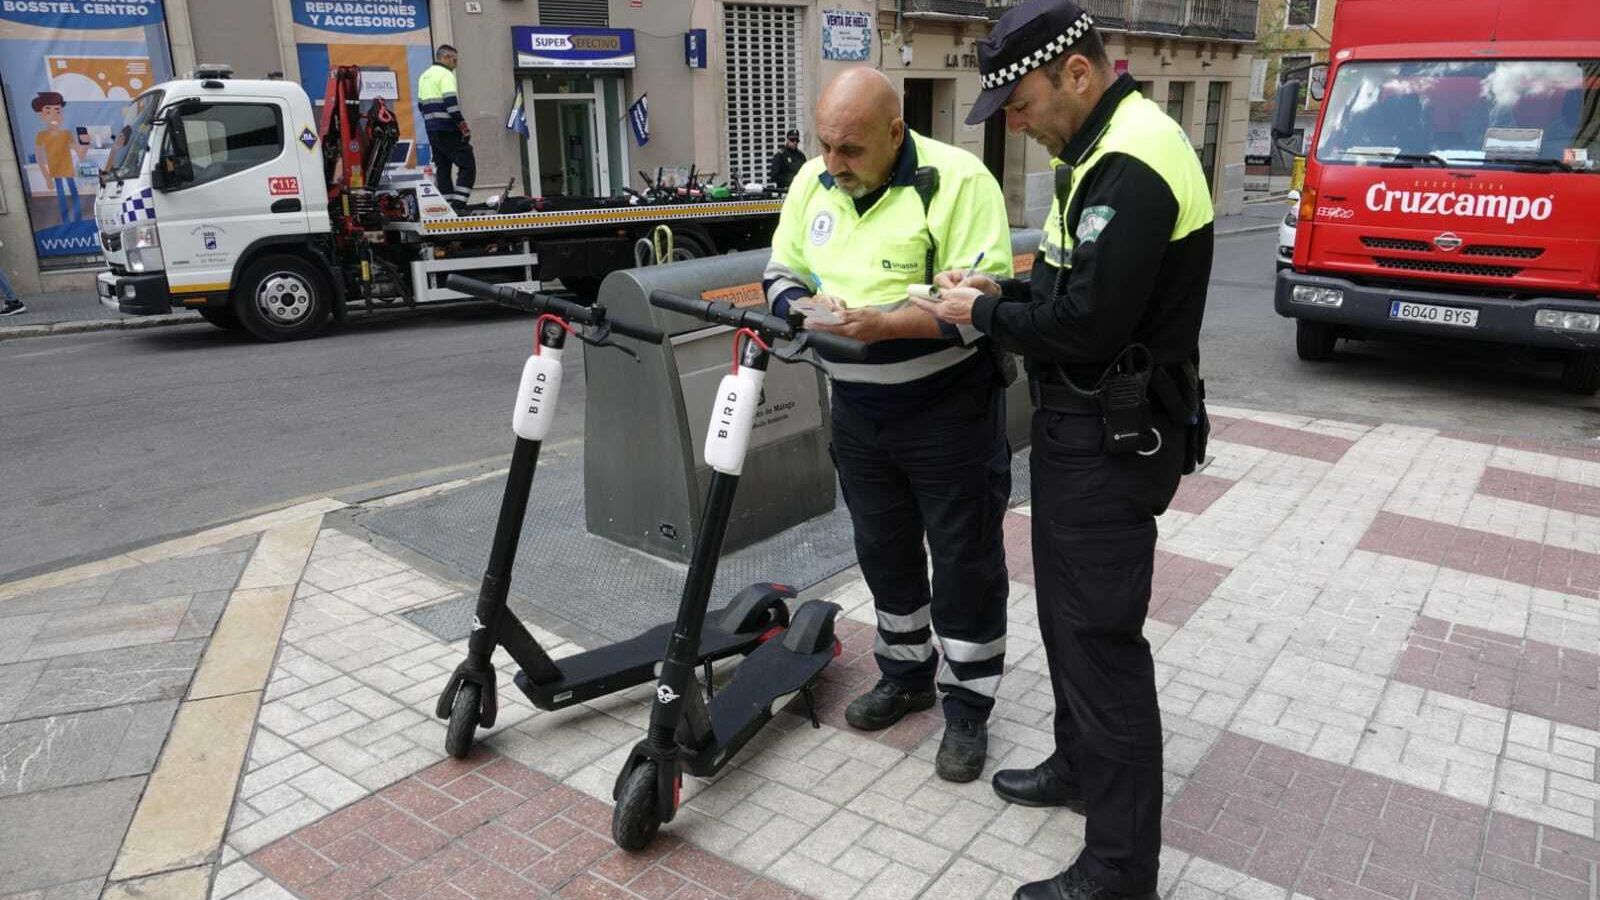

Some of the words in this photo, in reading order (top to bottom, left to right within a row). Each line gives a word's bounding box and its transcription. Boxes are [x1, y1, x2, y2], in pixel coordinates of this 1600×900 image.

[3, 1, 80, 14] BOSSTEL
[83, 3, 149, 16] CENTRO
[305, 2, 416, 16] REPARACIONES
[310, 14, 320, 26] Y
[324, 15, 415, 28] ACCESORIOS
[826, 14, 844, 26] VENTA
[845, 16, 852, 28] DE
[853, 16, 868, 28] HIELO
[535, 37, 567, 47] SUPER
[575, 38, 618, 49] EFECTIVO
[945, 53, 959, 68] LA
[962, 54, 977, 68] TR
[279, 179, 298, 190] 112
[1365, 181, 1552, 224] Cruzcampo
[1402, 304, 1438, 321] 6040
[1443, 308, 1472, 325] BYS
[528, 372, 547, 414] BIRD
[718, 391, 738, 439] BIRD
